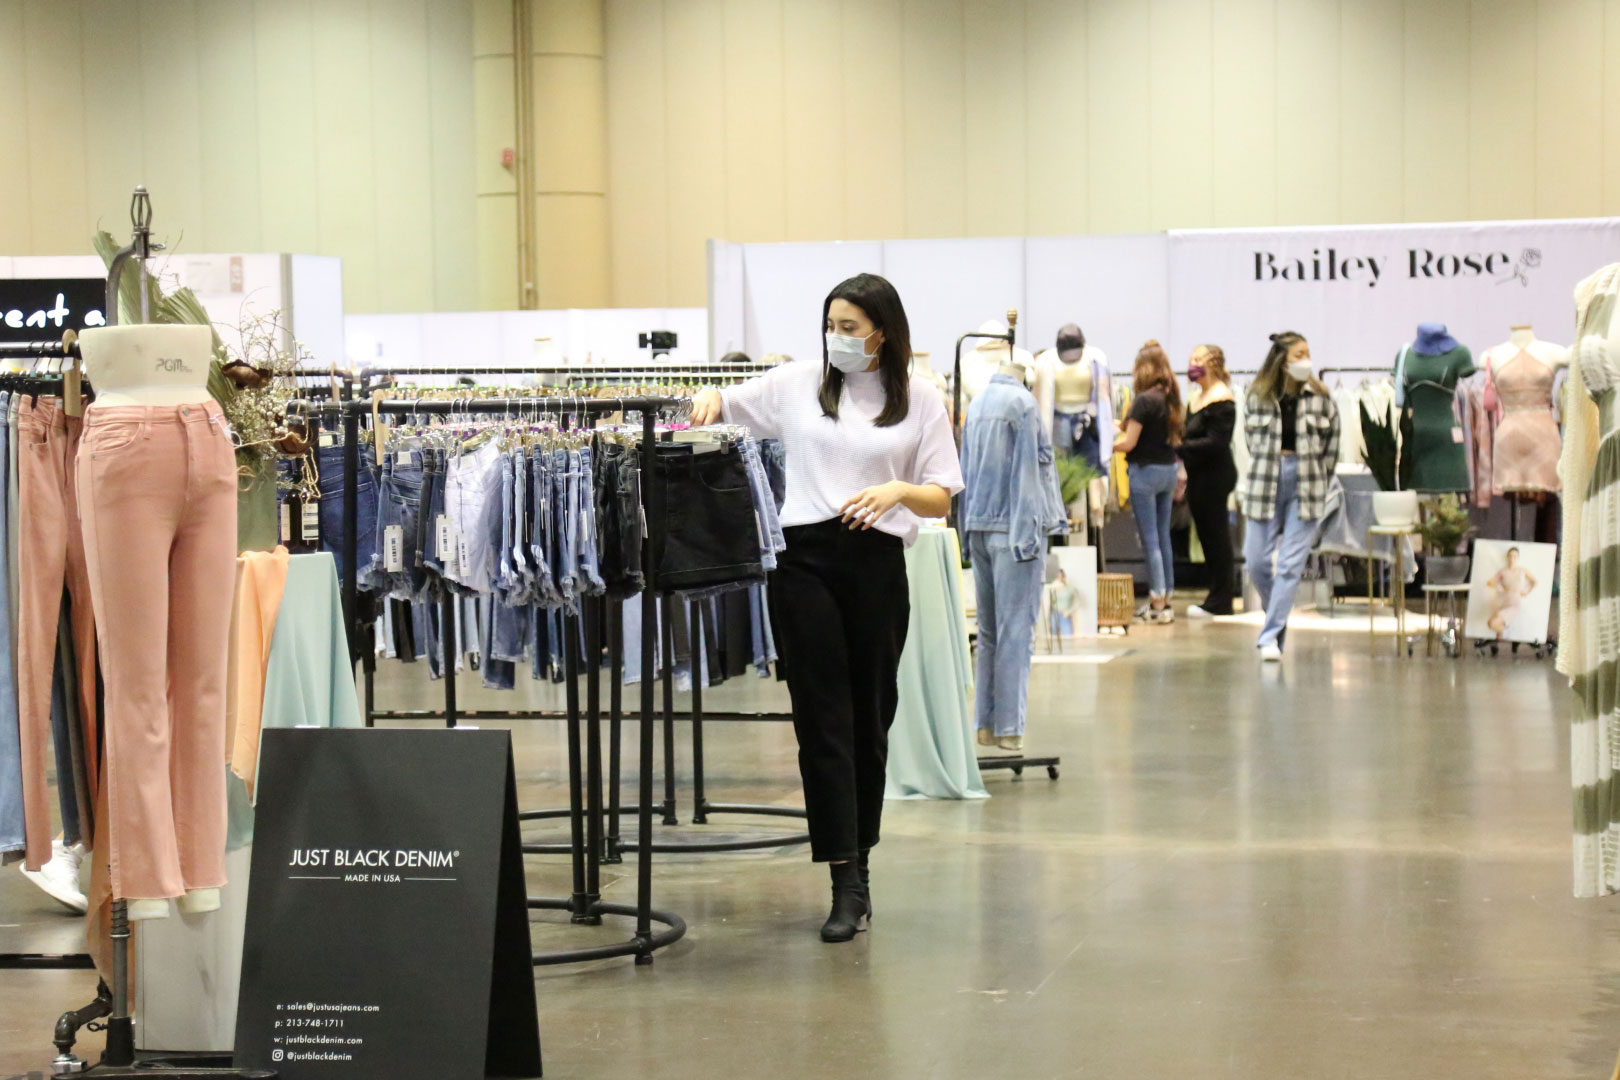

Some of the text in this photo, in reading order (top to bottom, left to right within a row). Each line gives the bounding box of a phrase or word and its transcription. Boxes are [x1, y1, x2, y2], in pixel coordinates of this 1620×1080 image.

[1253, 247, 1510, 288] Bailey Rose
[0, 292, 70, 329] ent
[289, 849, 330, 866] JUST
[334, 849, 390, 867] BLACK
[344, 874, 369, 882] MADE
[383, 875, 401, 883] USA
[276, 1001, 380, 1013] e: sales@justusajeans.com
[274, 1018, 344, 1029] p: 213-748-1711
[285, 1034, 363, 1045] justblackdenim.com
[287, 1050, 353, 1062] @justblackdenim
